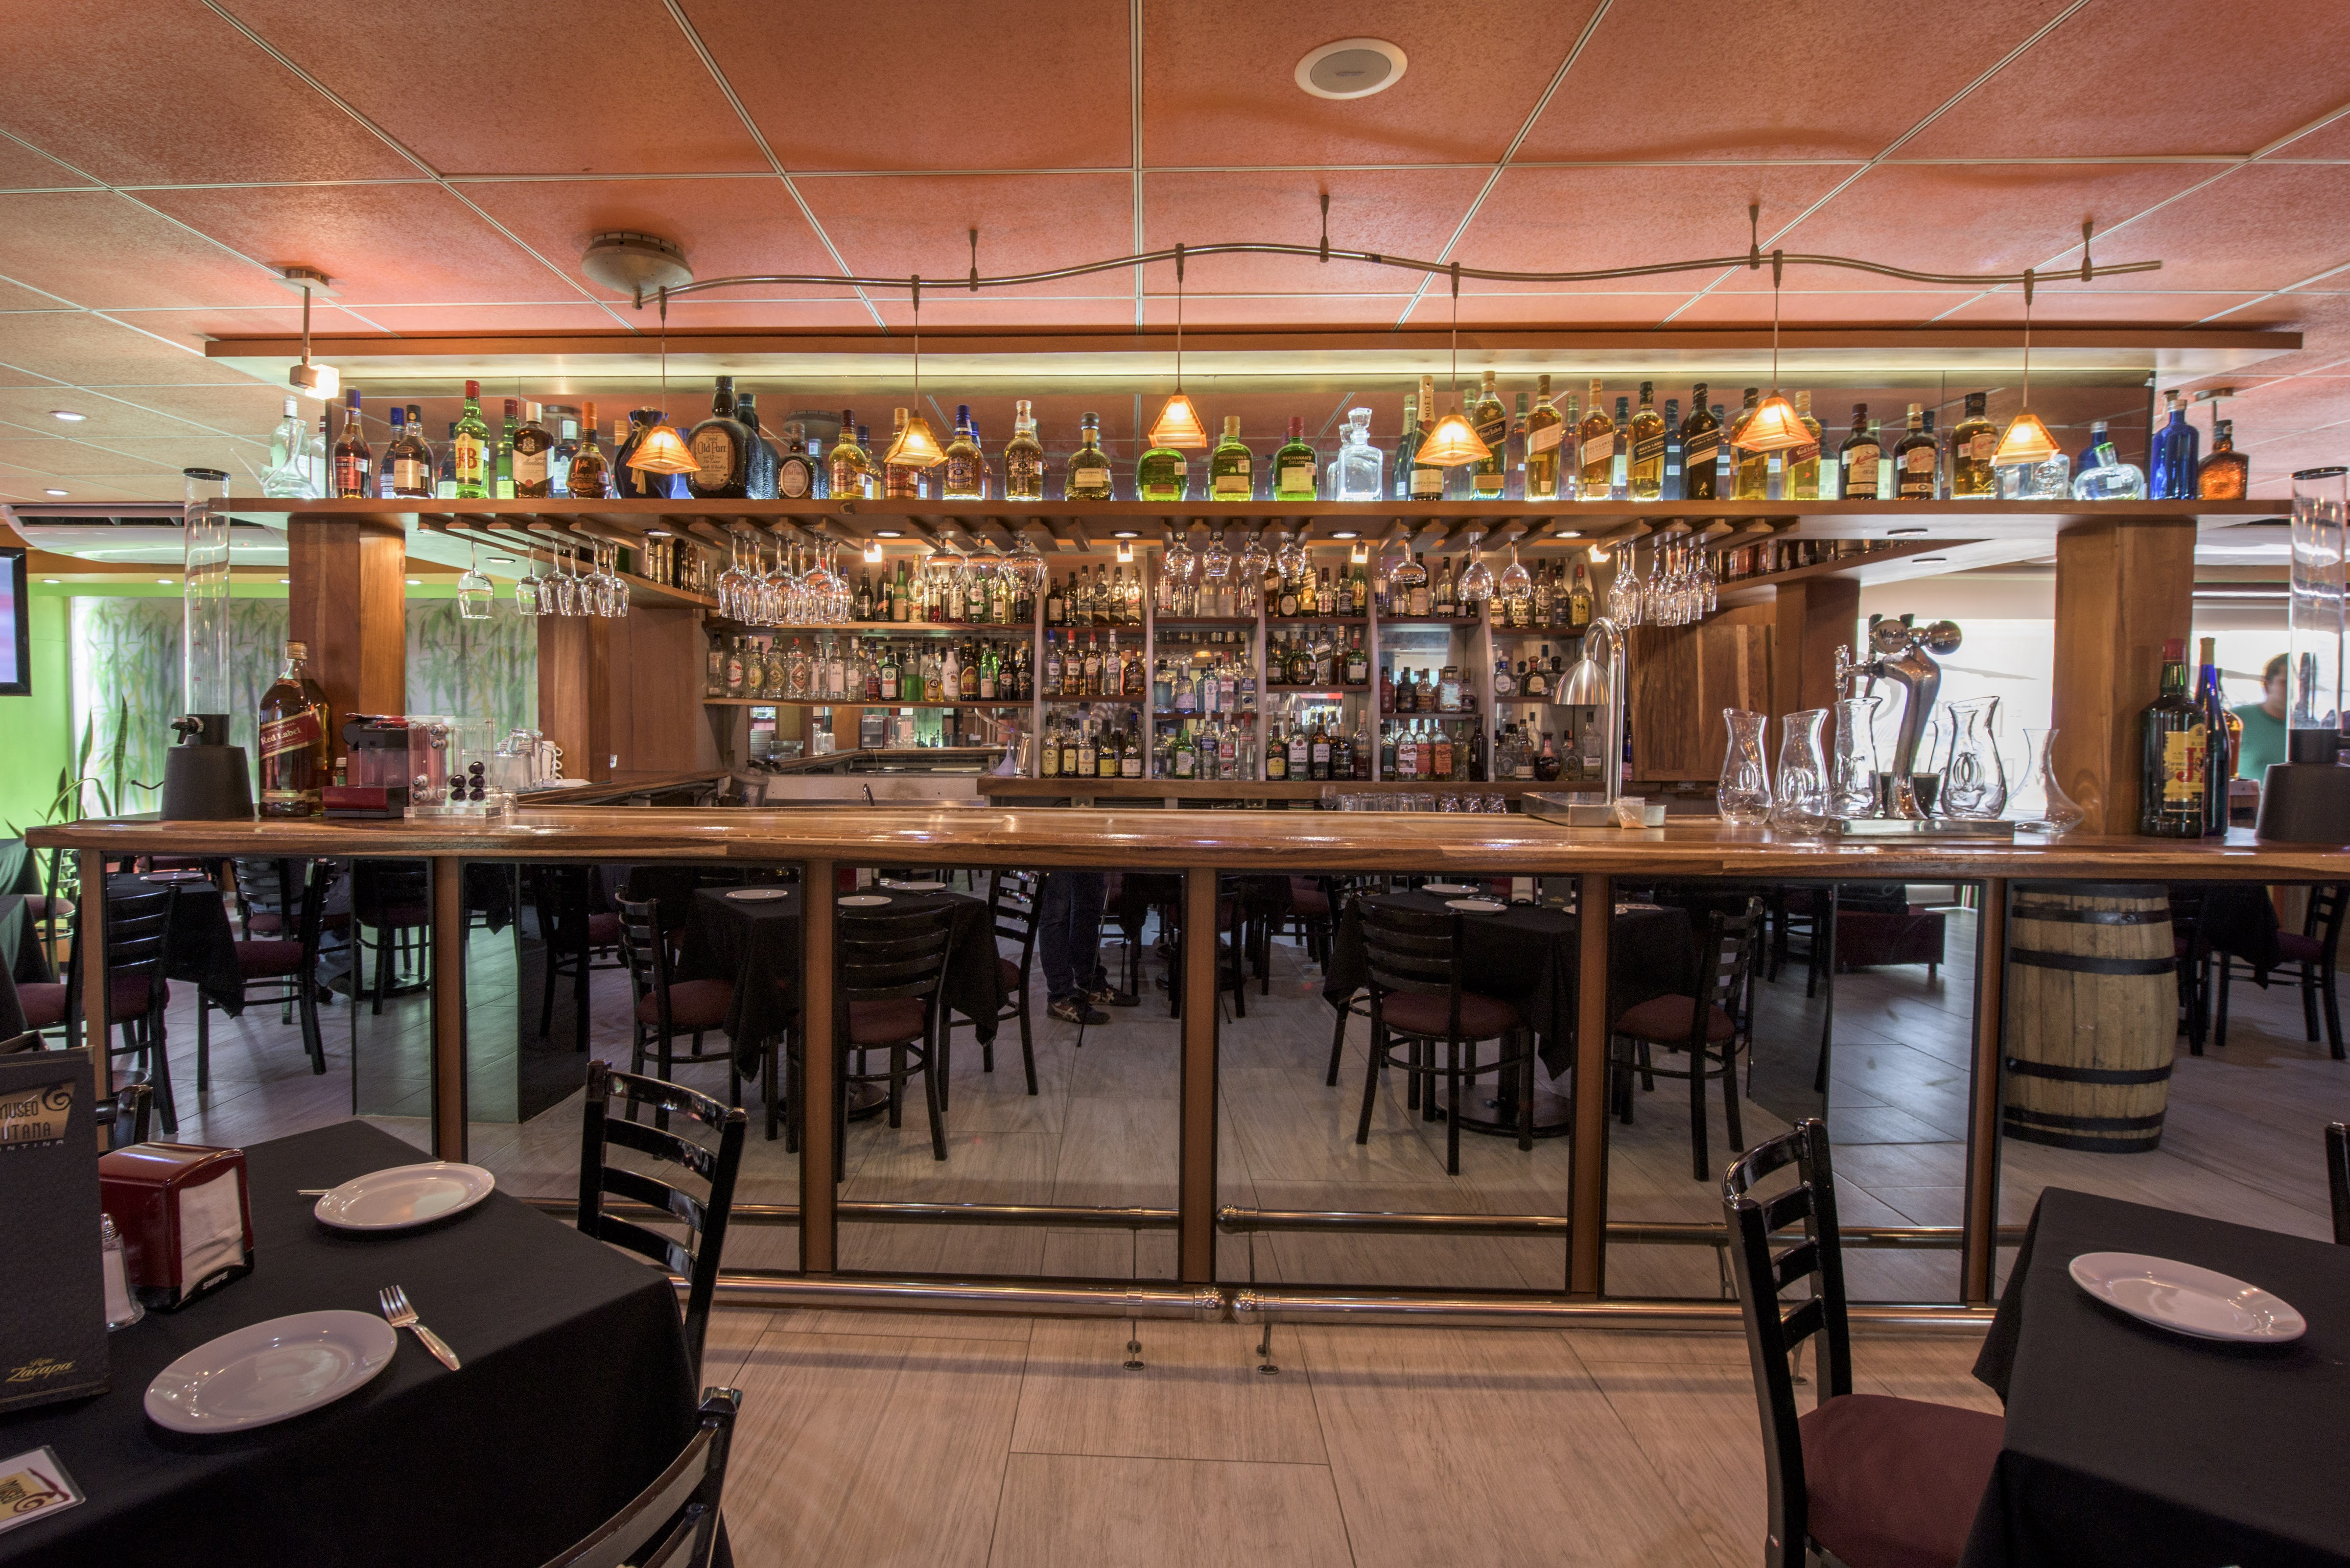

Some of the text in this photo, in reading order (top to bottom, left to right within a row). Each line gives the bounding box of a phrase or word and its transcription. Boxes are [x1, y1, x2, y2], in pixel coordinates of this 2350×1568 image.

[1489, 426, 1503, 436] Label
[698, 442, 727, 454] Old Parr
[456, 447, 477, 469] J&B
[260, 734, 277, 745] Red
[277, 727, 302, 739] Label
[202, 1271, 229, 1290] SWIPE
[5, 1359, 76, 1383] Zacapa
